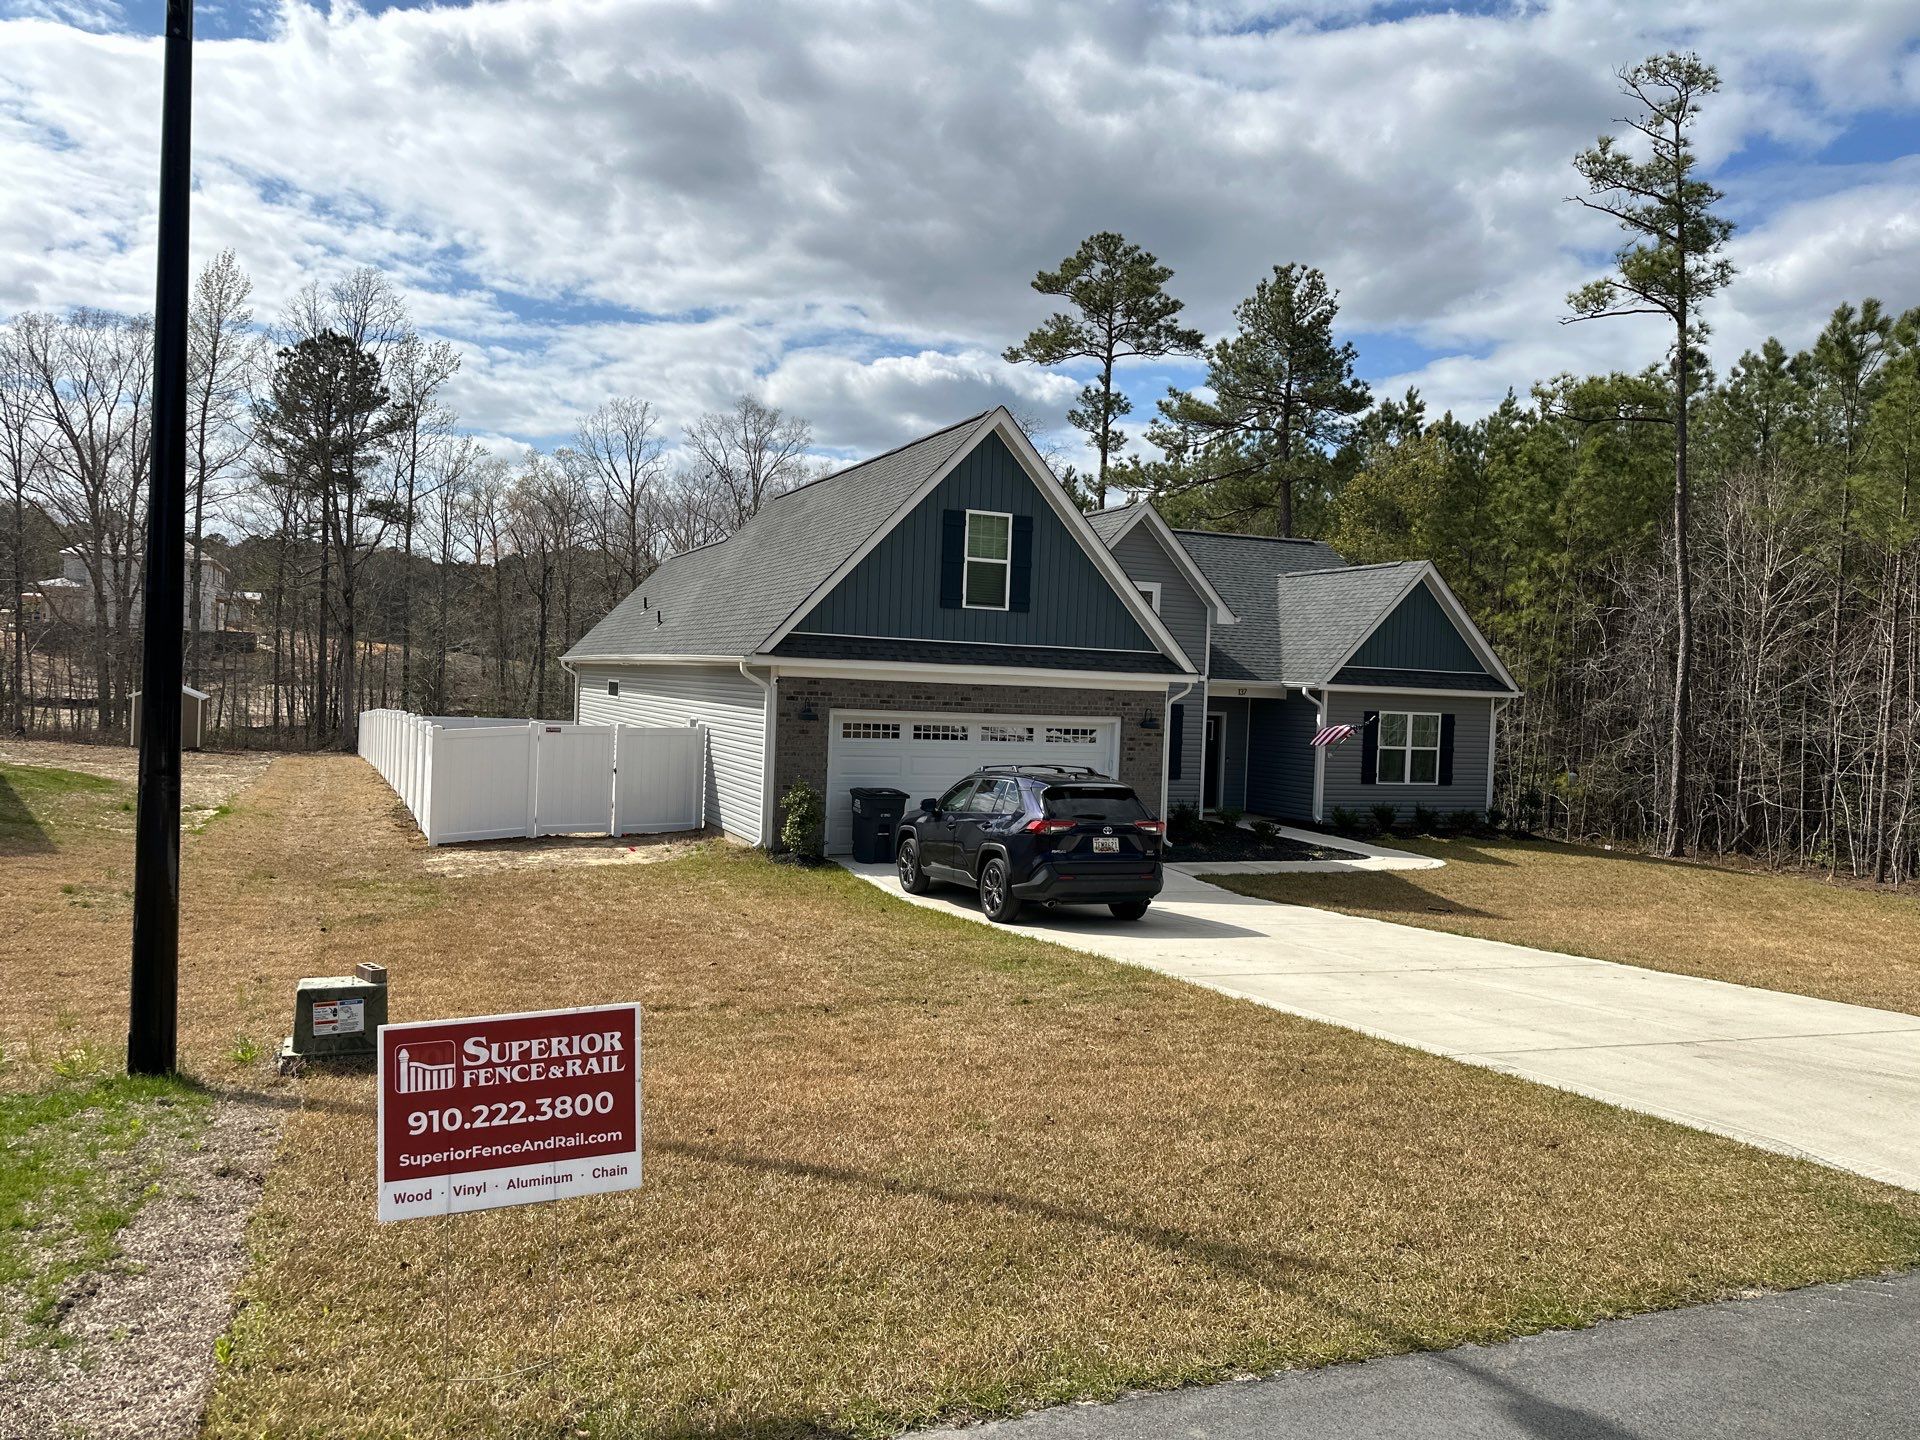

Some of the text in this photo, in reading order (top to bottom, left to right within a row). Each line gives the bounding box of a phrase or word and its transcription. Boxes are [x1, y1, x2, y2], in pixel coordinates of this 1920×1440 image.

[462, 1031, 624, 1067] SUPERIOR
[407, 1091, 614, 1136] 910.222.3800
[399, 1130, 622, 1167] SuperiorFenceAndRail.com
[394, 1165, 628, 1204] Wood Vinyl Aluminum Chain
